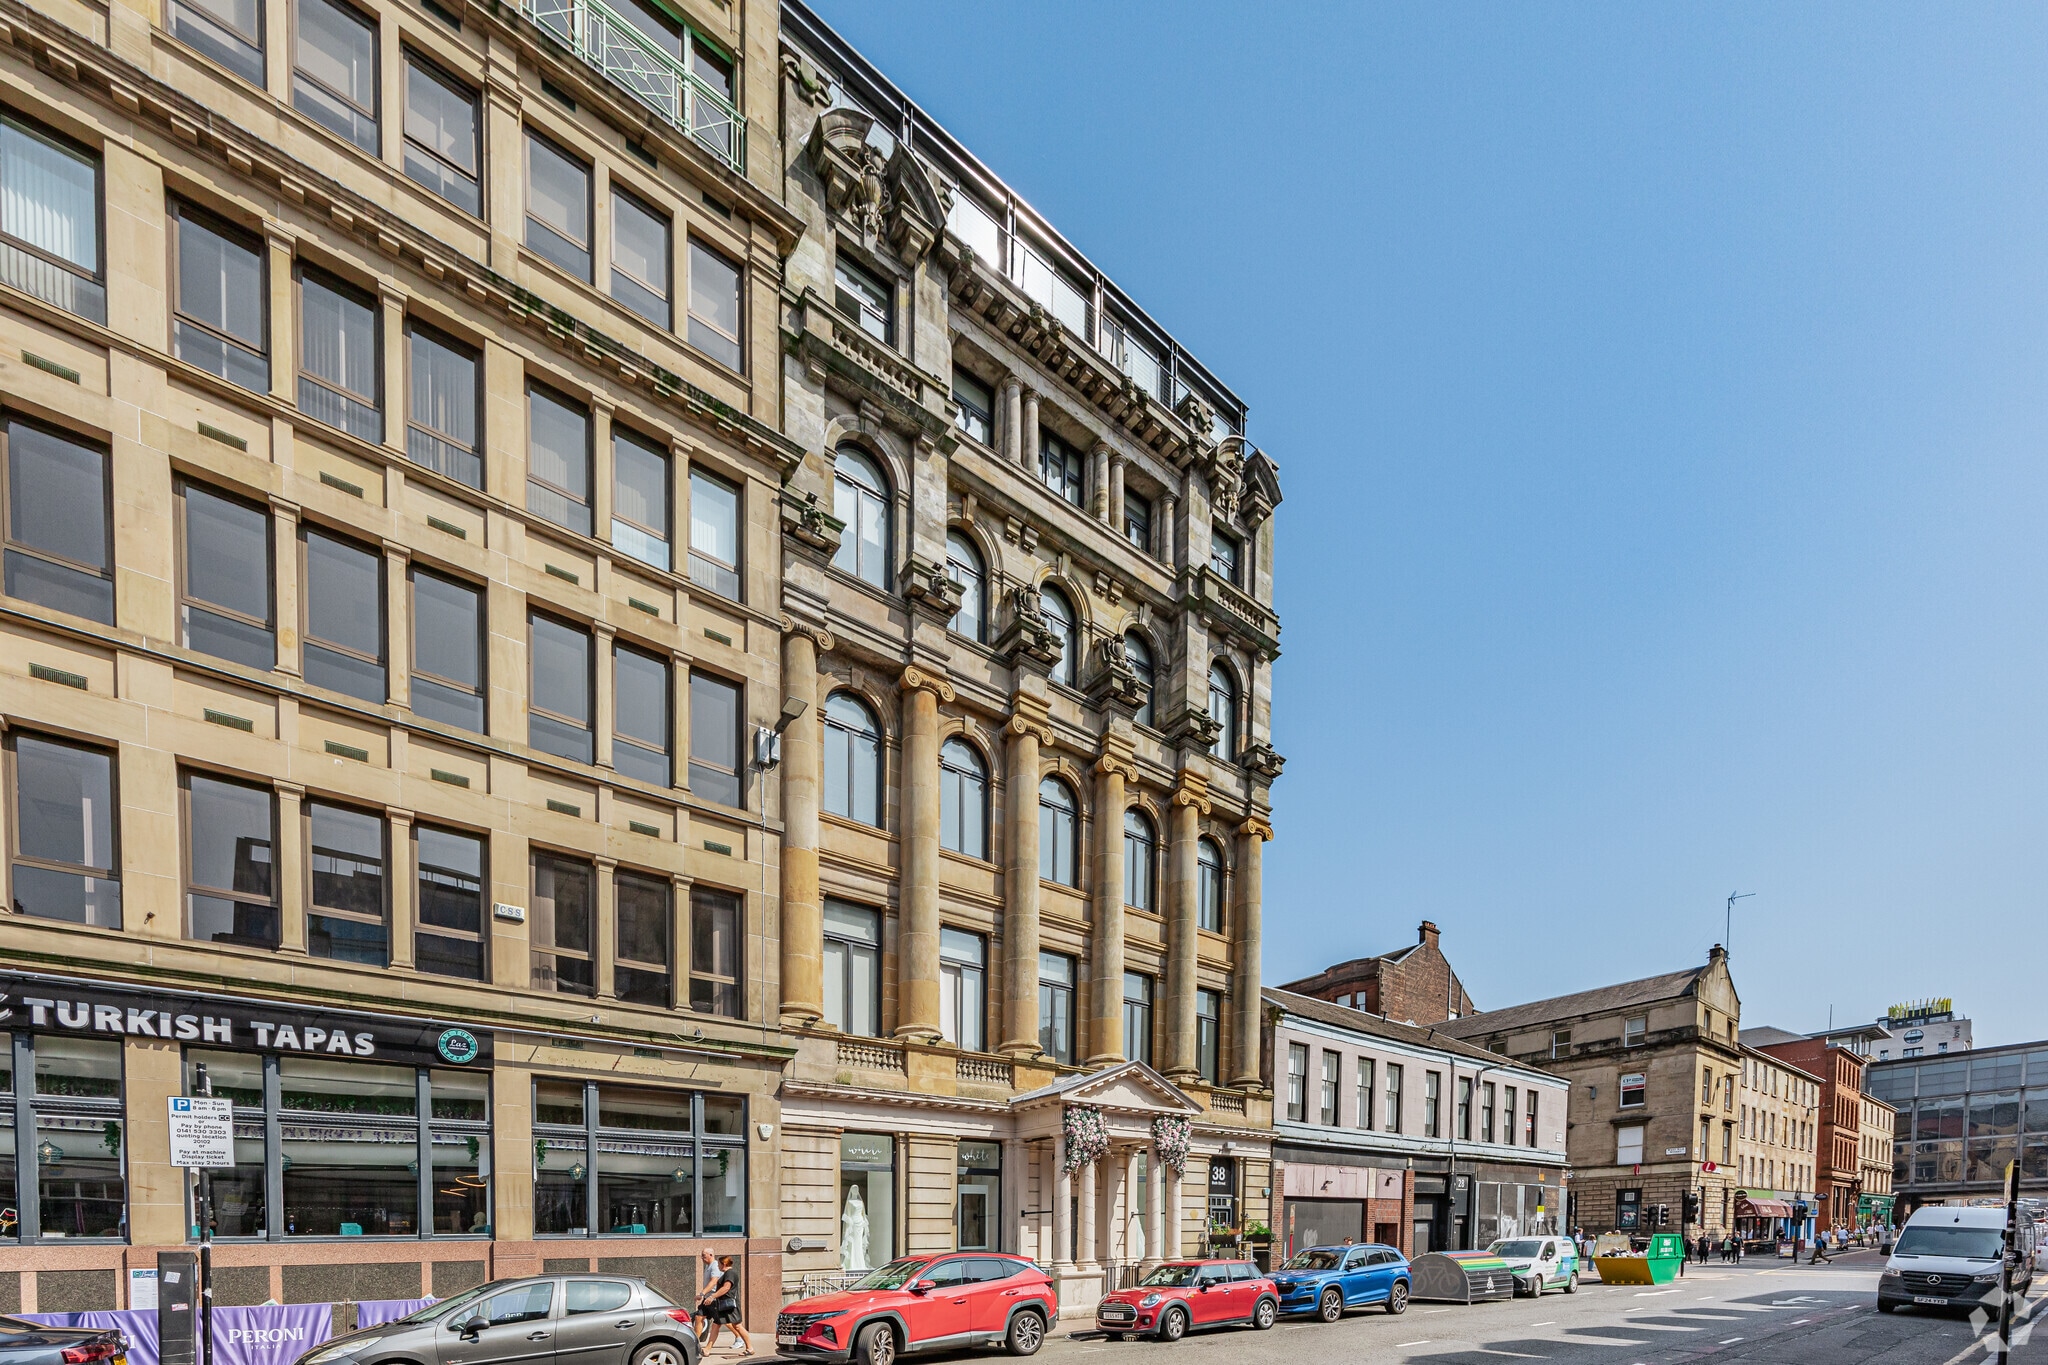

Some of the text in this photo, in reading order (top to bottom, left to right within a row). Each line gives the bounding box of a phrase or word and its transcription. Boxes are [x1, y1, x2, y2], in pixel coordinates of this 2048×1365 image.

[23, 996, 232, 1043] TURKISH
[250, 1020, 375, 1056] TAPAS
[450, 1039, 468, 1048] Laz
[178, 1100, 188, 1110] P
[1212, 1166, 1225, 1180] 38
[1458, 1180, 1465, 1188] 28
[228, 1328, 304, 1344] PERONI
